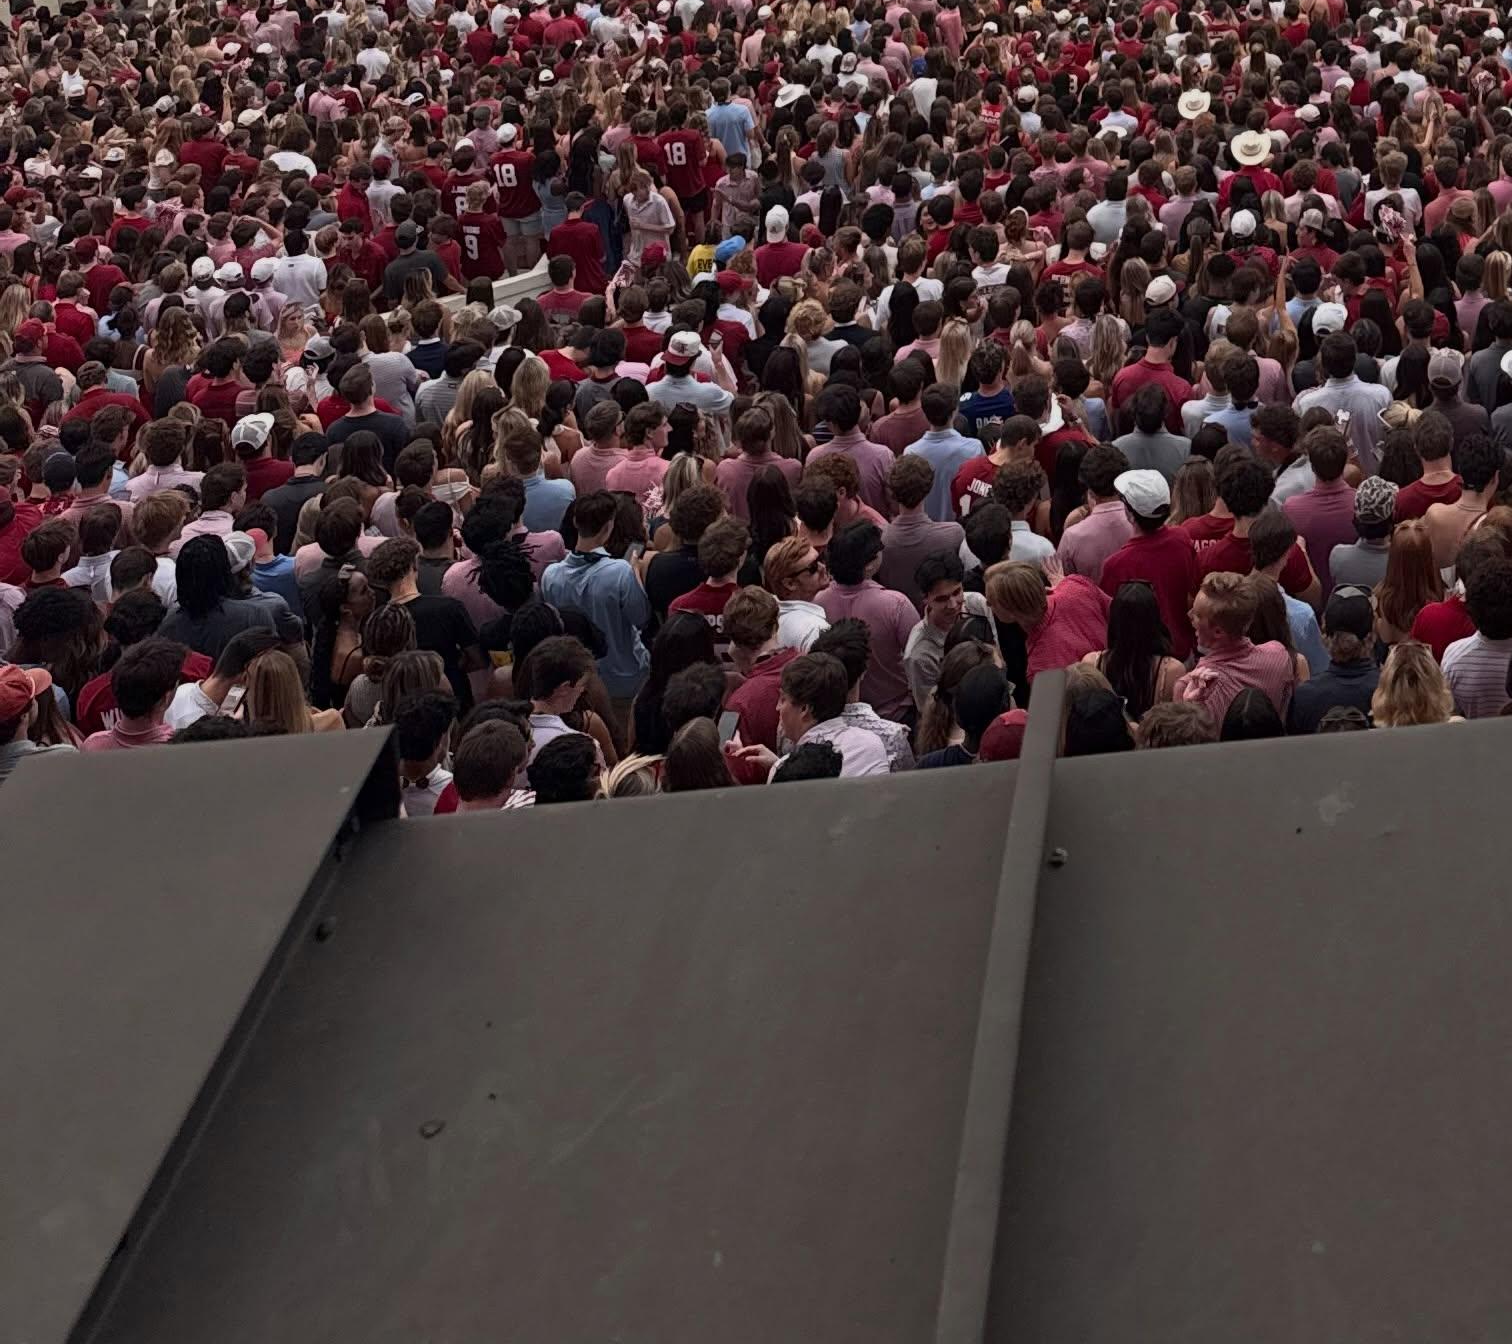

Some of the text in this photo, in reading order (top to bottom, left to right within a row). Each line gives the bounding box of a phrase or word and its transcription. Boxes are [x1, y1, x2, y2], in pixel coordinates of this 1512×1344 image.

[664, 141, 688, 166] 18
[493, 163, 518, 187] 18
[464, 234, 479, 260] 9
[697, 258, 713, 270] EVE
[967, 478, 993, 498] JONE
